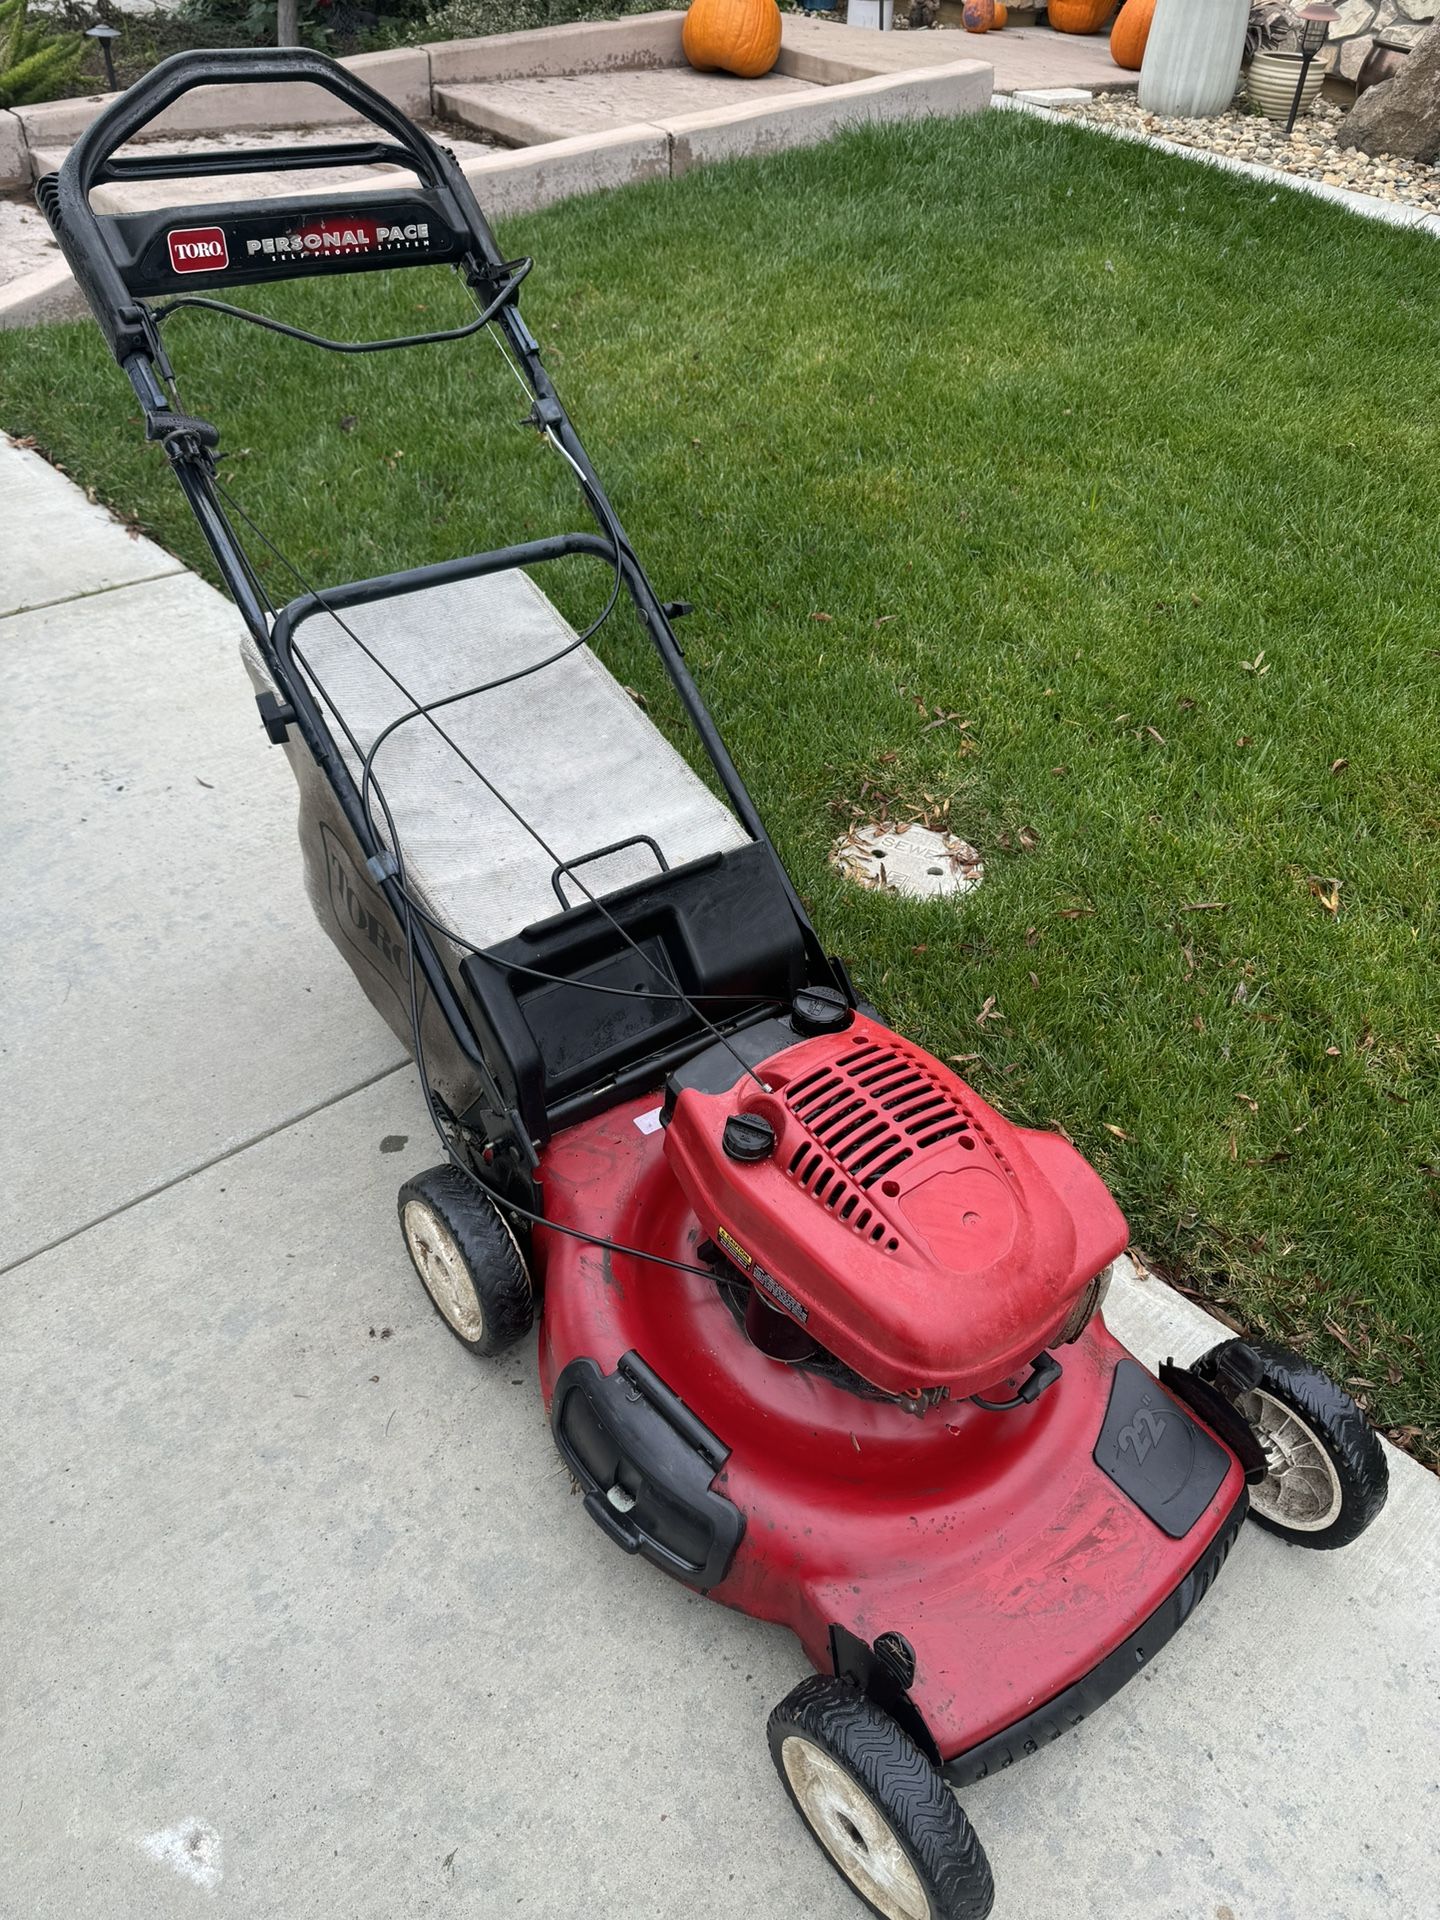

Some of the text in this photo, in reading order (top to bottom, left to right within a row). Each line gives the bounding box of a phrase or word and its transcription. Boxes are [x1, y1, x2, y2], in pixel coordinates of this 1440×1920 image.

[246, 223, 429, 256] PERSONAL PACE
[272, 240, 430, 262] SELF PROPEL SYSTEM
[881, 836, 947, 863] SEWE
